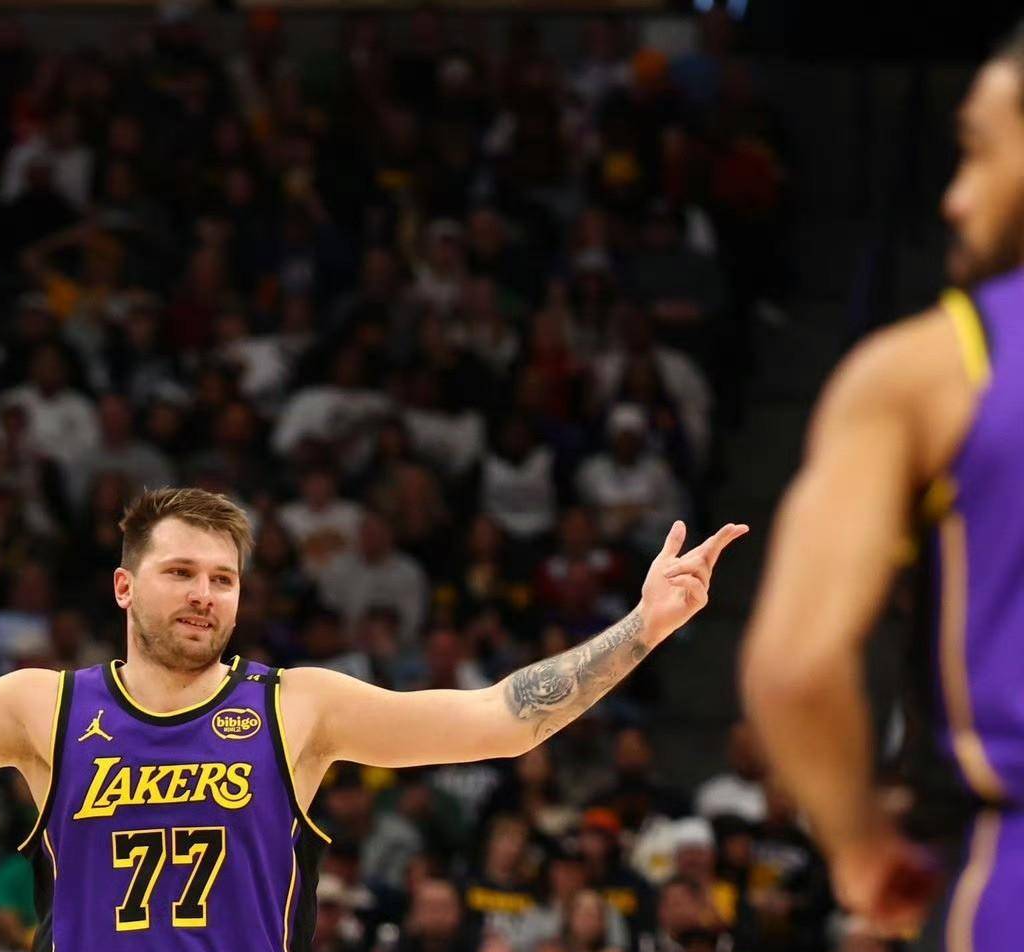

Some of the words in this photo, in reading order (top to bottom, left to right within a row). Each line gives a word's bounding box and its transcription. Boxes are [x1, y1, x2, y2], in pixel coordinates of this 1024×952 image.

[216, 716, 258, 730] bibigo
[73, 756, 253, 820] LAKERS
[112, 826, 227, 931] 77
